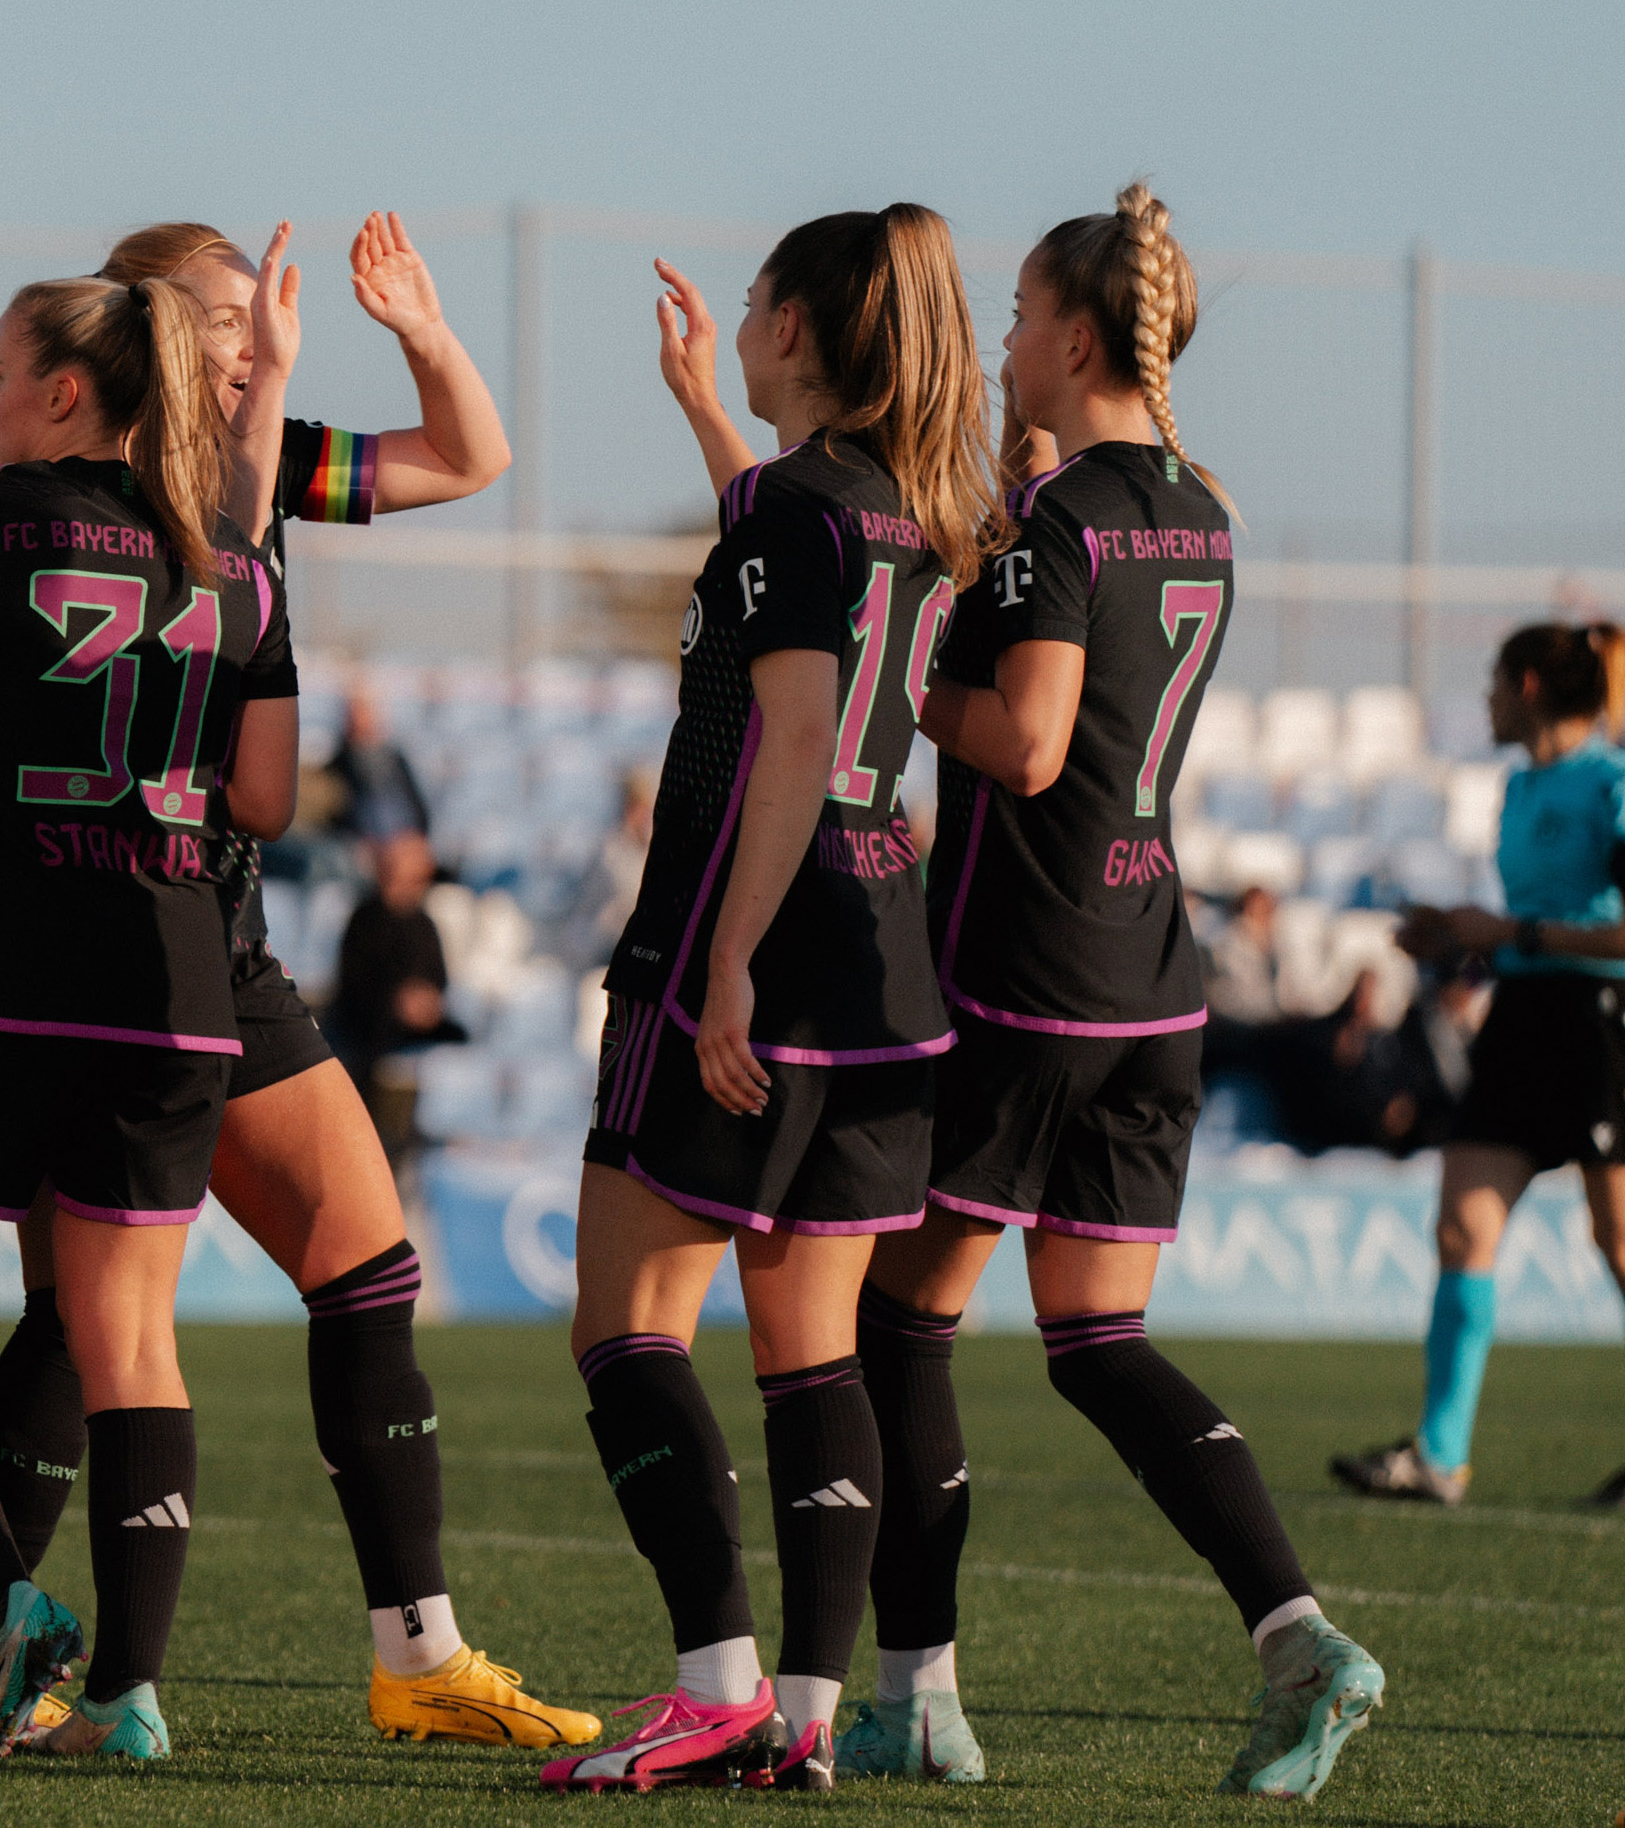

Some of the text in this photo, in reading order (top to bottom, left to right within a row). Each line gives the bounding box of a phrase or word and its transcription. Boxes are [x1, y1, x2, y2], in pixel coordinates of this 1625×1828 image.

[2, 522, 39, 552] FC
[50, 520, 154, 560] BAYERN
[1098, 530, 1127, 561] FC
[1130, 528, 1207, 560] BAYERN
[17, 568, 222, 827] 31
[1133, 579, 1224, 819] 7
[387, 1423, 415, 1439] FC
[0, 1446, 27, 1469] FC
